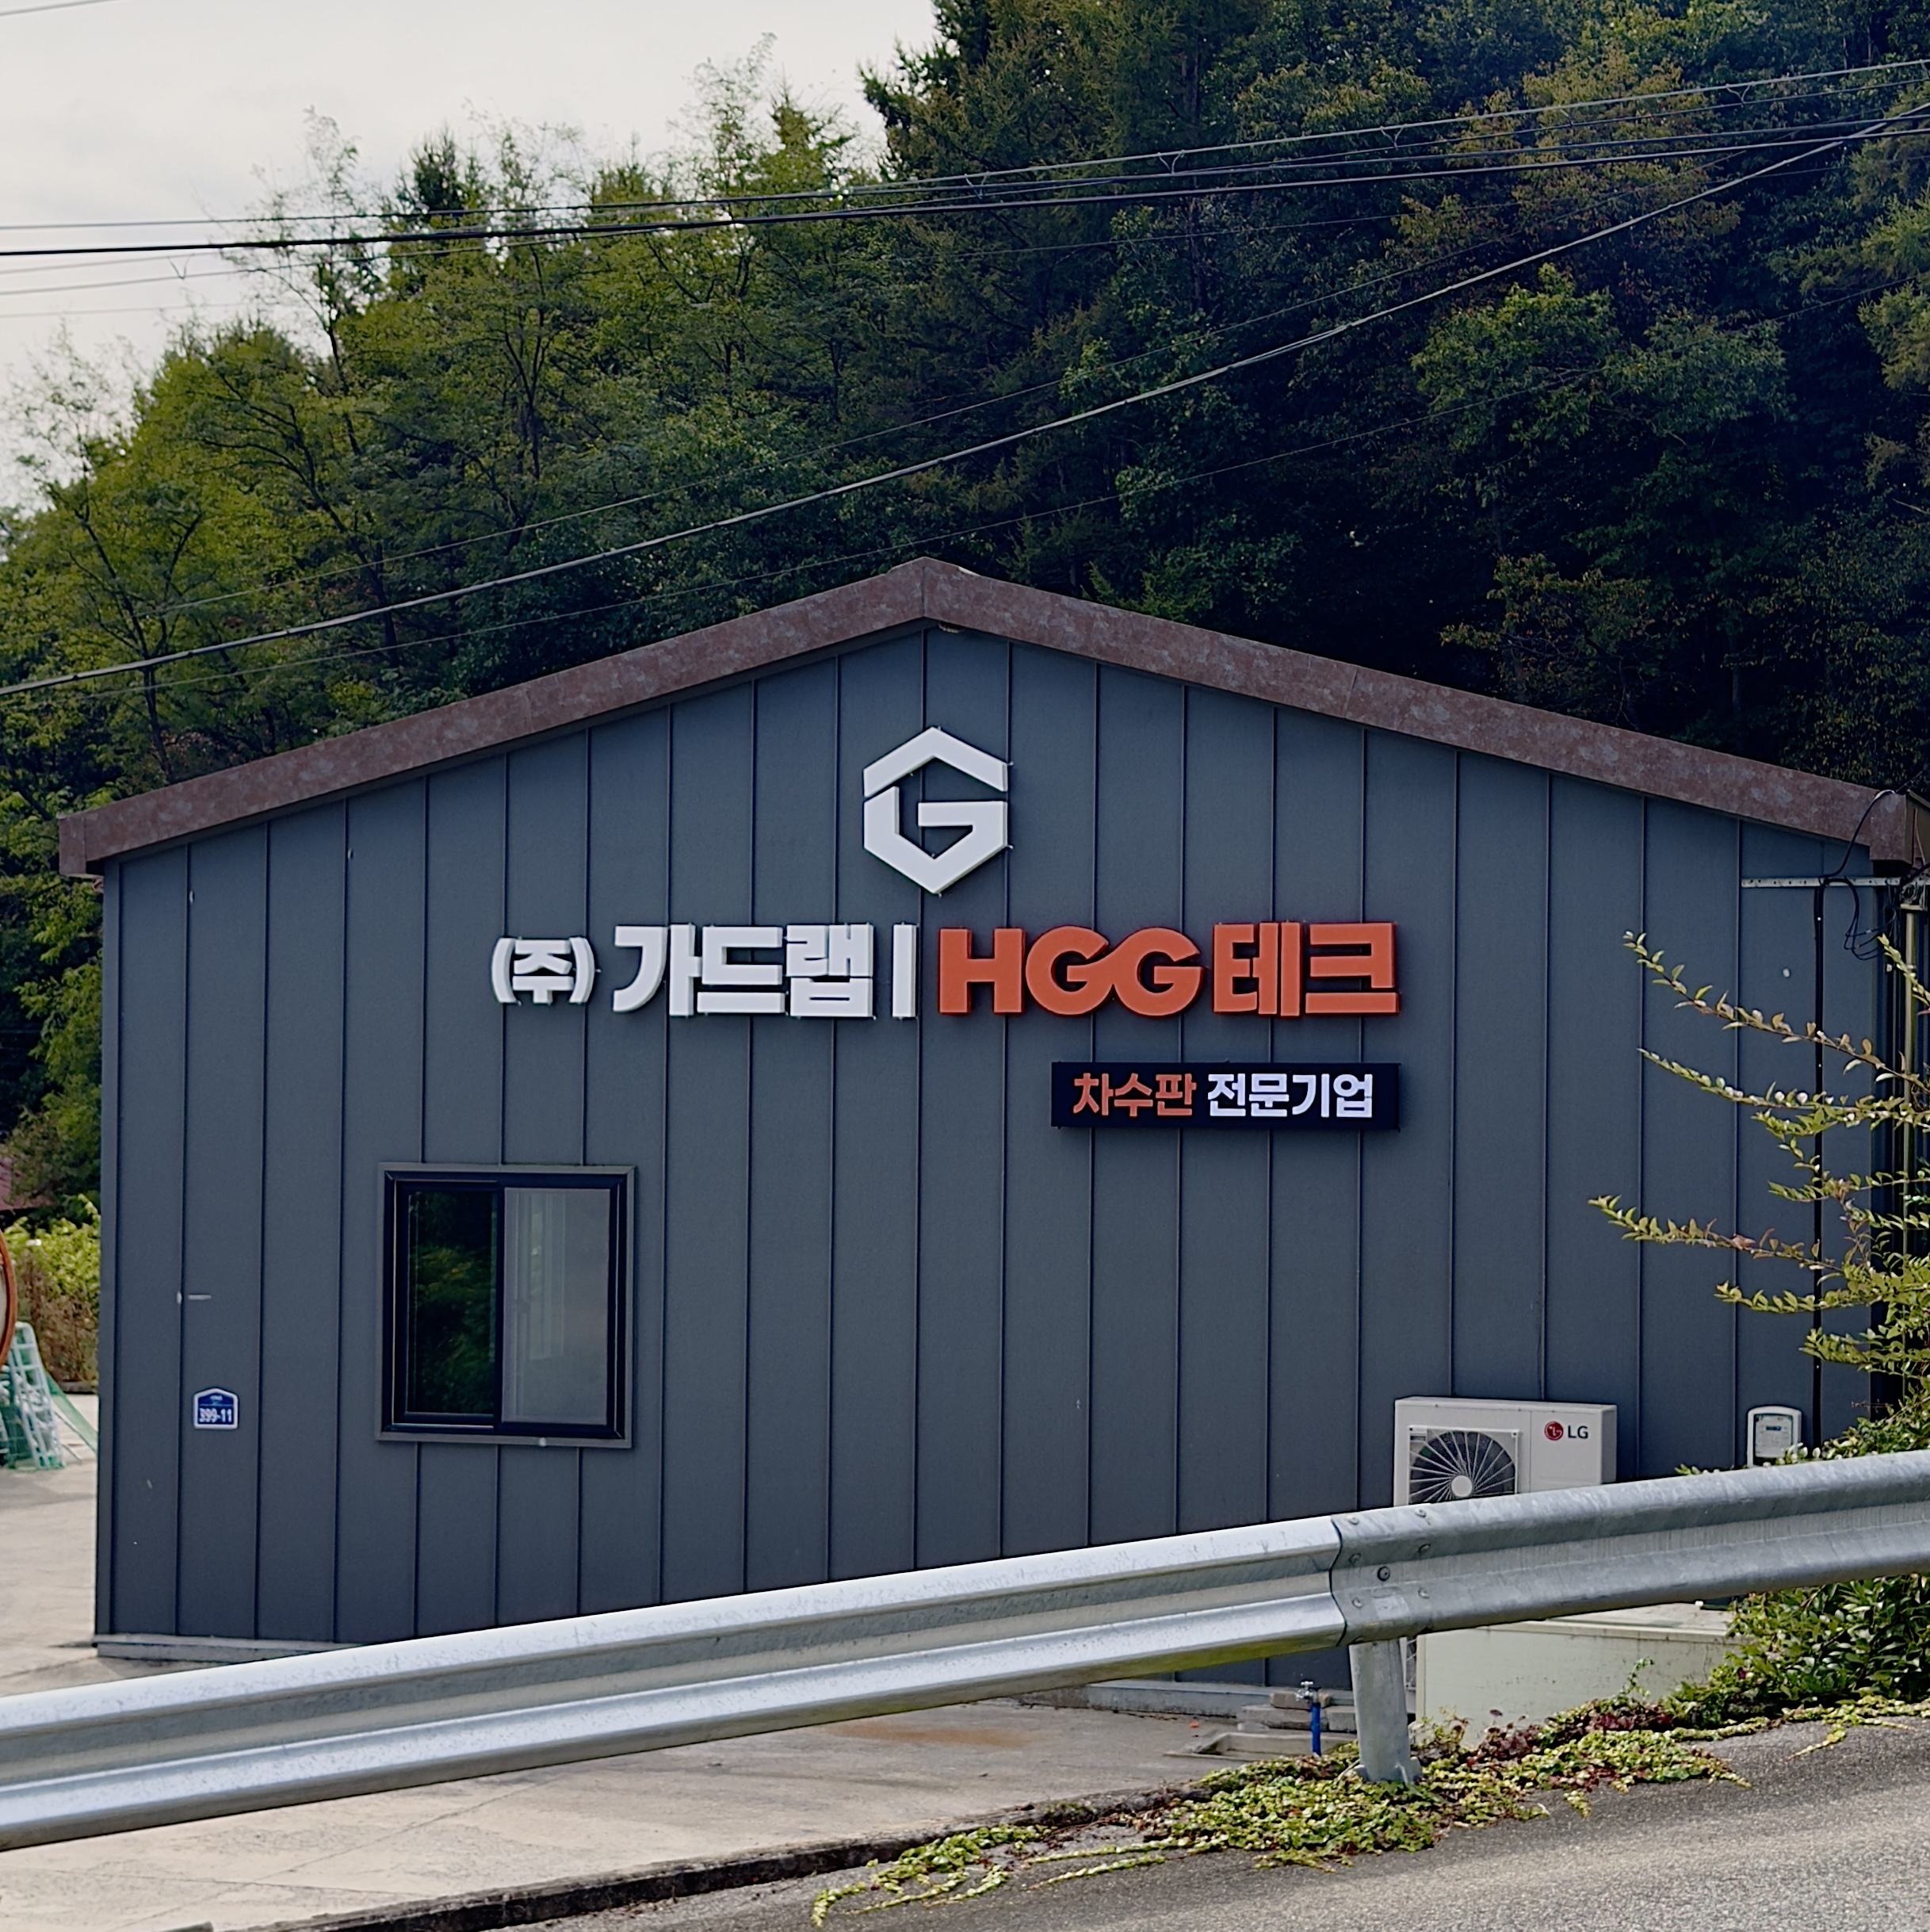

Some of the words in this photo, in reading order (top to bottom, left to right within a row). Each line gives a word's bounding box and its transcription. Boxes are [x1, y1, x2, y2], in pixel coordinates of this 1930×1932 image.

[613, 923, 874, 1018] 가드랩
[1072, 1073, 1196, 1116] 차수판
[1208, 1073, 1373, 1119] 전문기업
[1568, 1425, 1588, 1439] LG
